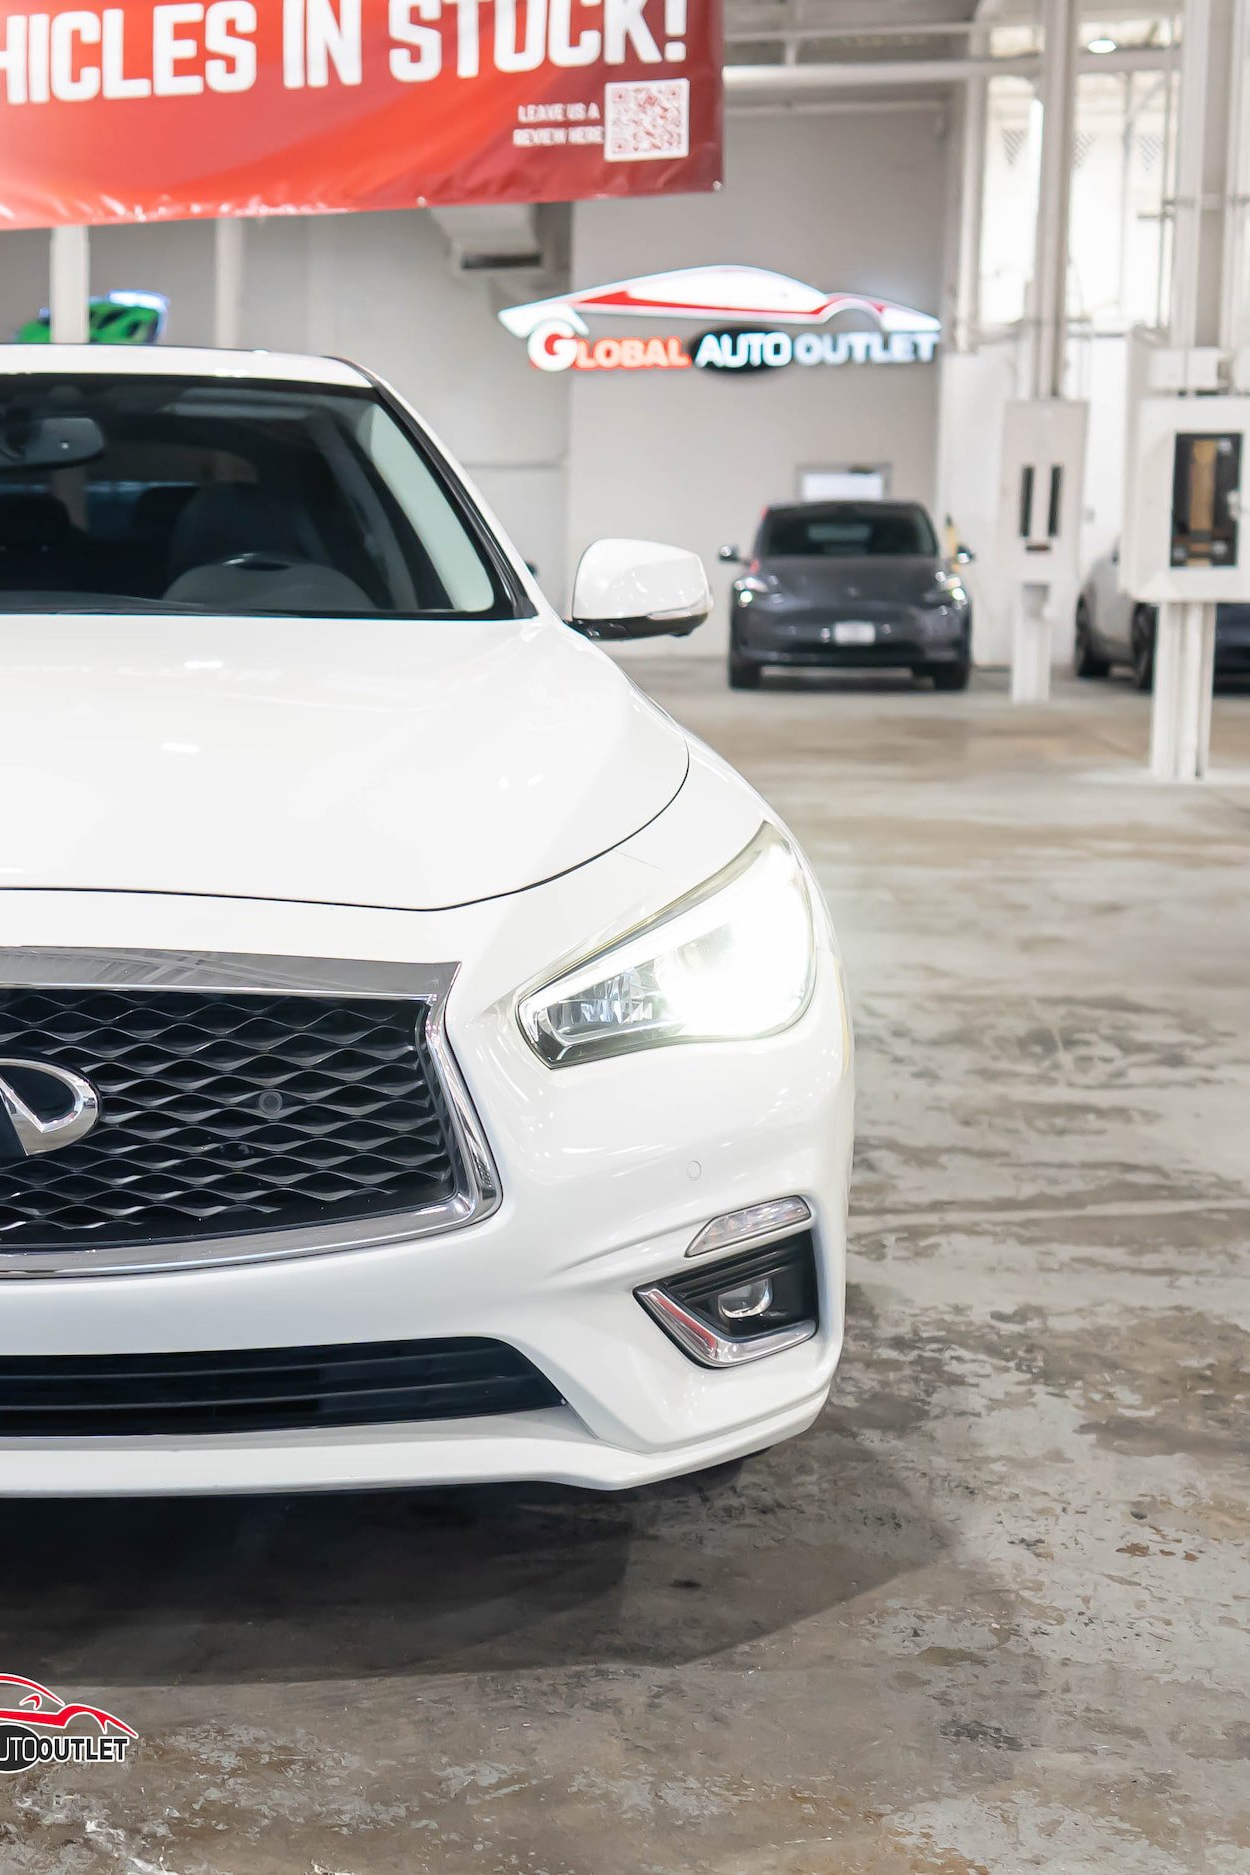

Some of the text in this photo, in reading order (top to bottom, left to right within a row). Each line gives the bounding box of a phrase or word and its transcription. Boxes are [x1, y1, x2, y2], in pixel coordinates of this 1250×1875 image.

[283, 0, 362, 89] IN
[388, 0, 687, 82] STOCK!
[518, 103, 564, 123] LEAVE
[588, 102, 601, 119] A
[527, 319, 940, 372] GLOBAL AUTO OUTLET
